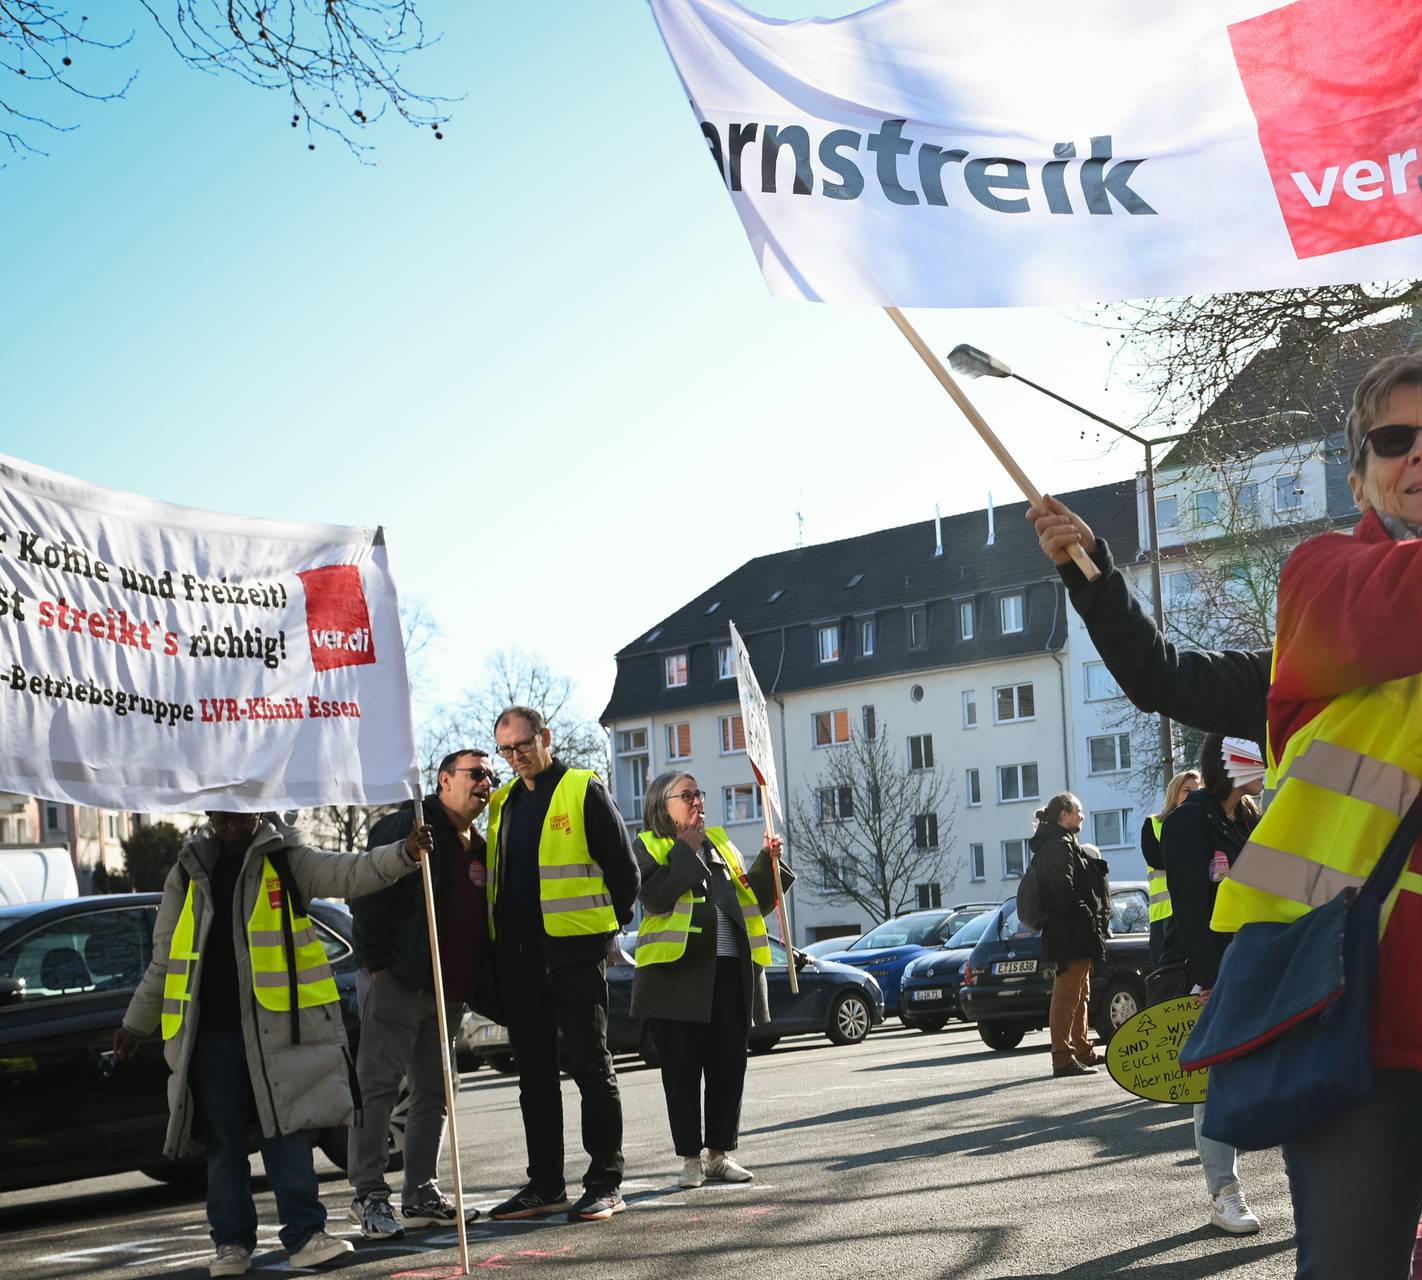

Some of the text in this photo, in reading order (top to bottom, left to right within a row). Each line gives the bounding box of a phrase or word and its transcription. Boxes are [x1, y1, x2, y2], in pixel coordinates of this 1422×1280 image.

[18, 530, 109, 583] Kohle
[119, 565, 176, 600] und
[183, 573, 288, 609] Freizeit!
[189, 625, 287, 669] richtig!
[312, 627, 369, 652] ver.di
[0, 665, 361, 726] -Betriebsgruppe LVR-Klinik Essen
[1118, 1040, 1149, 1058] SIND
[1122, 1053, 1160, 1072] EUCH
[1133, 1075, 1160, 1090] Aber
[1164, 1064, 1192, 1082] nic
[1169, 1081, 1190, 1100] 8%
